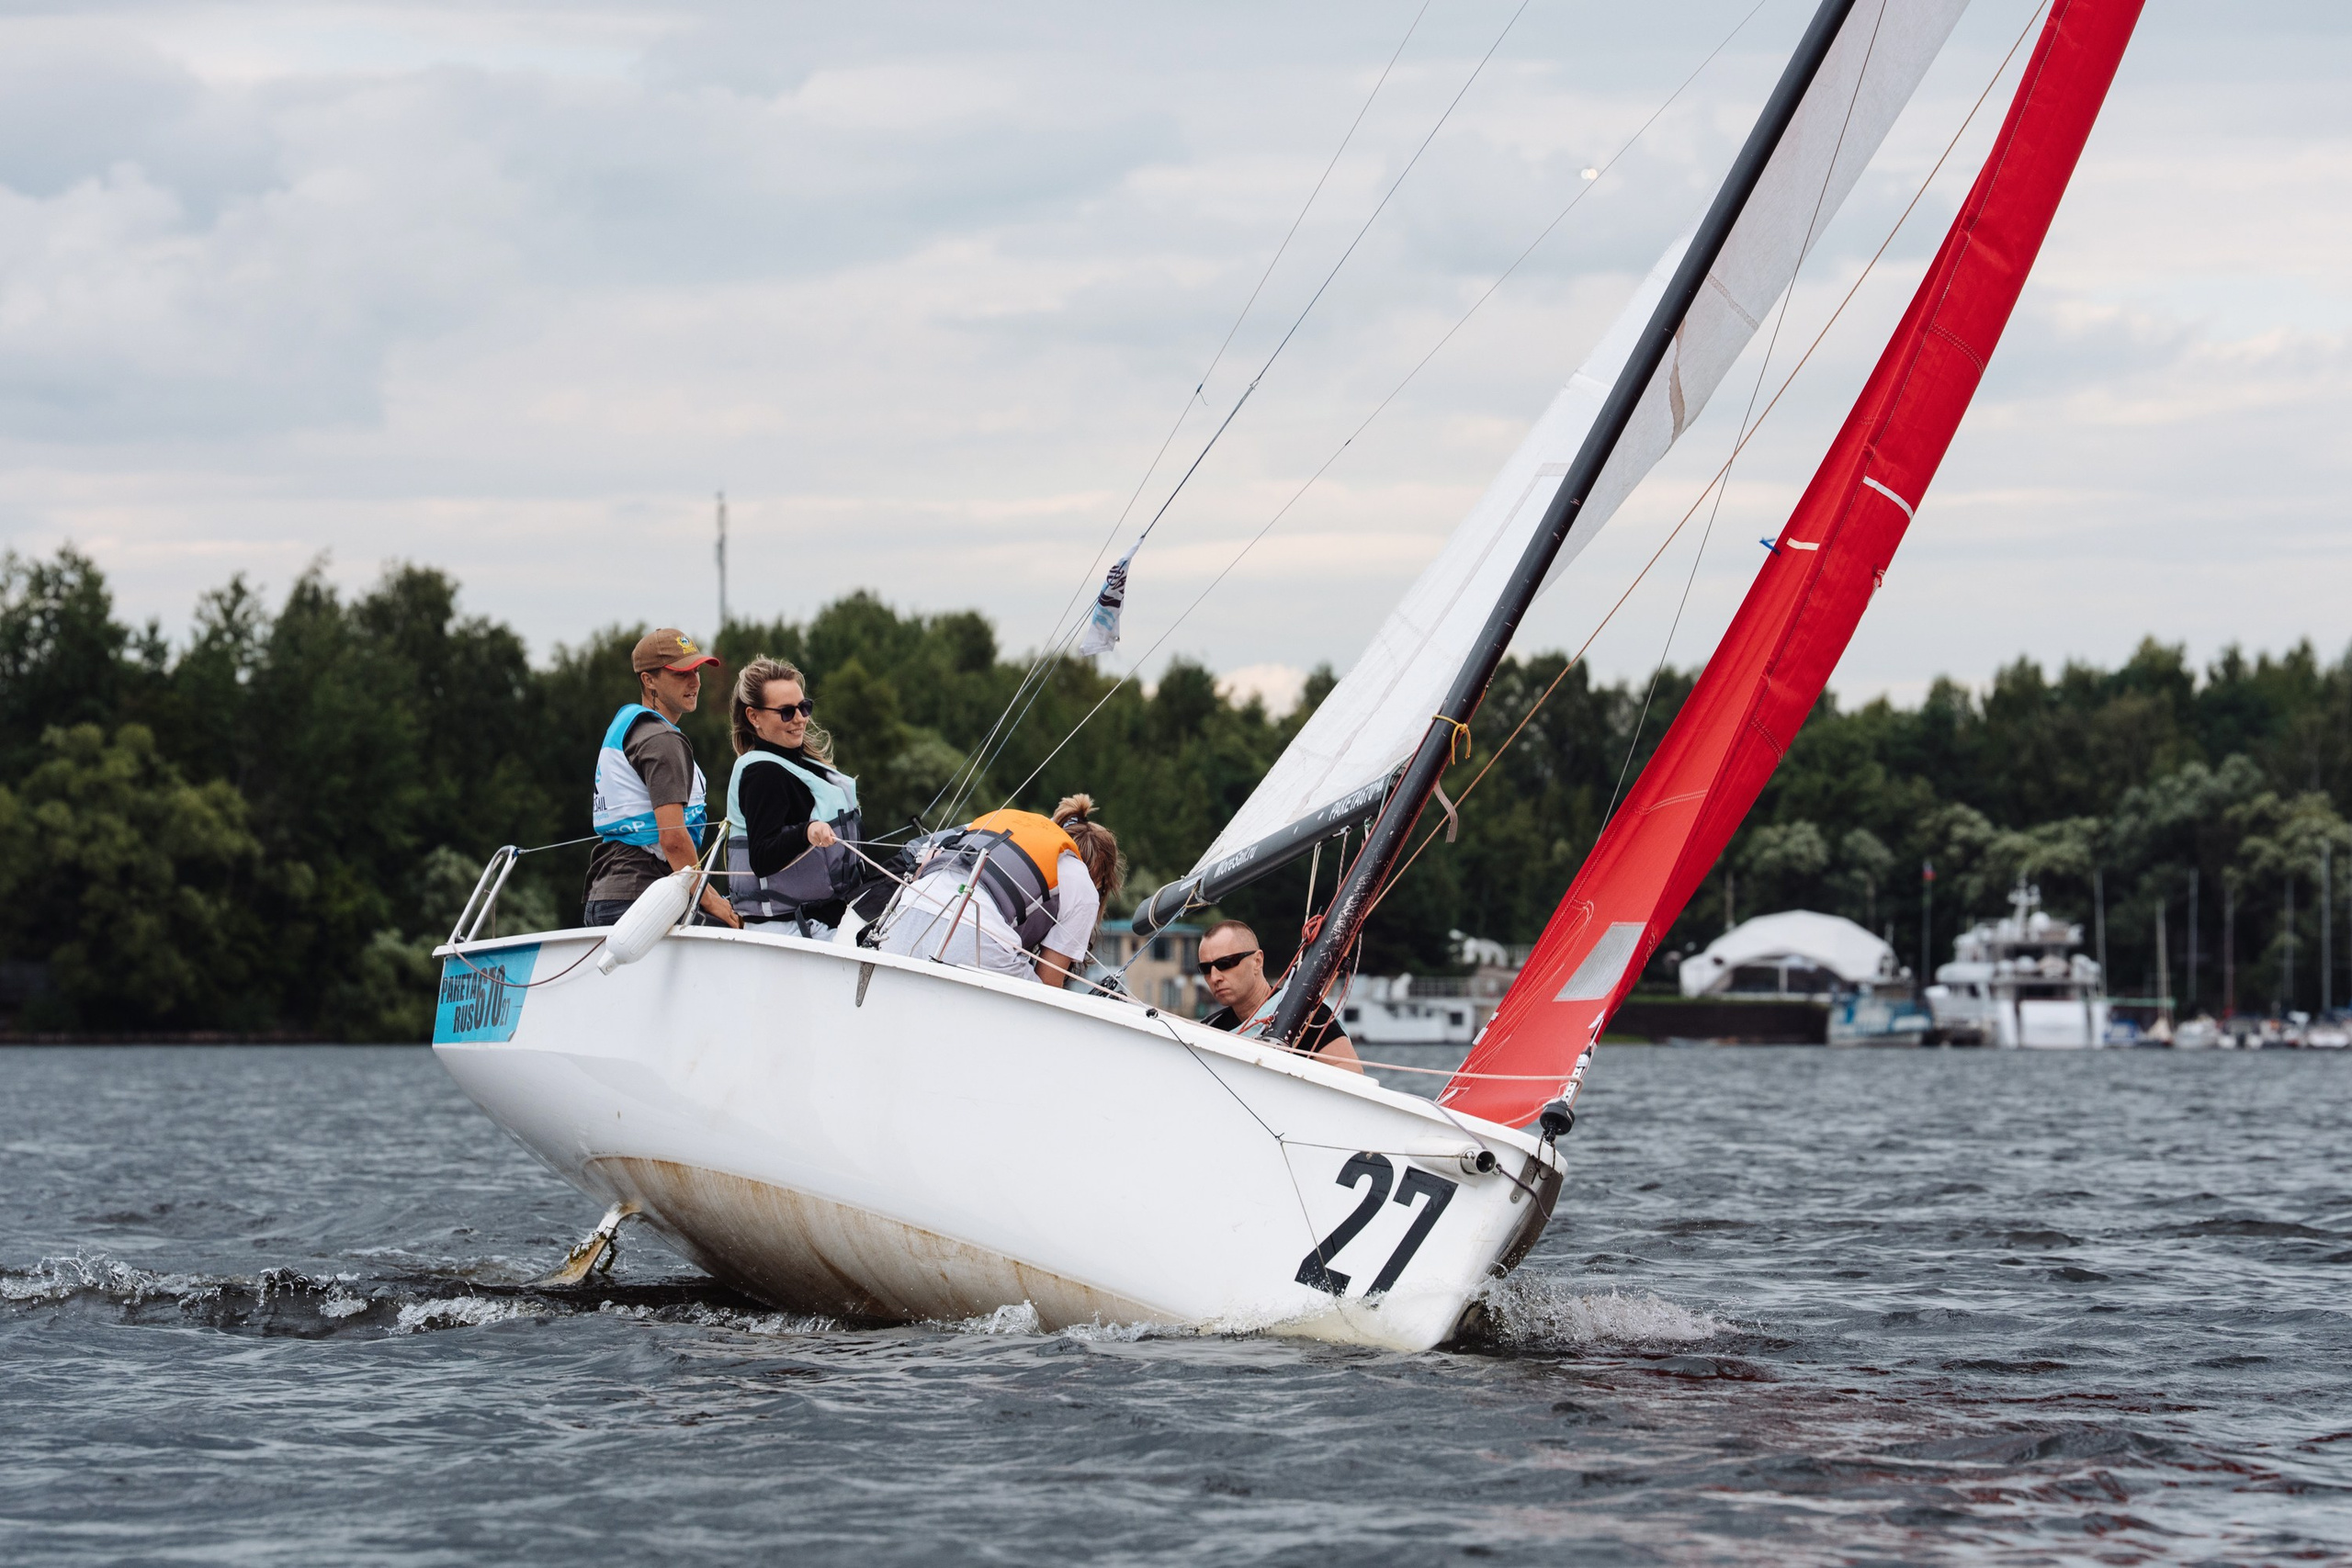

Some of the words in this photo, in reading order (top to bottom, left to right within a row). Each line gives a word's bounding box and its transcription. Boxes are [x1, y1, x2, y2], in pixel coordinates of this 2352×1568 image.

[453, 1003, 474, 1033] RUS
[501, 998, 510, 1026] 27
[474, 964, 505, 1029] 670
[1294, 1151, 1459, 1298] 27
